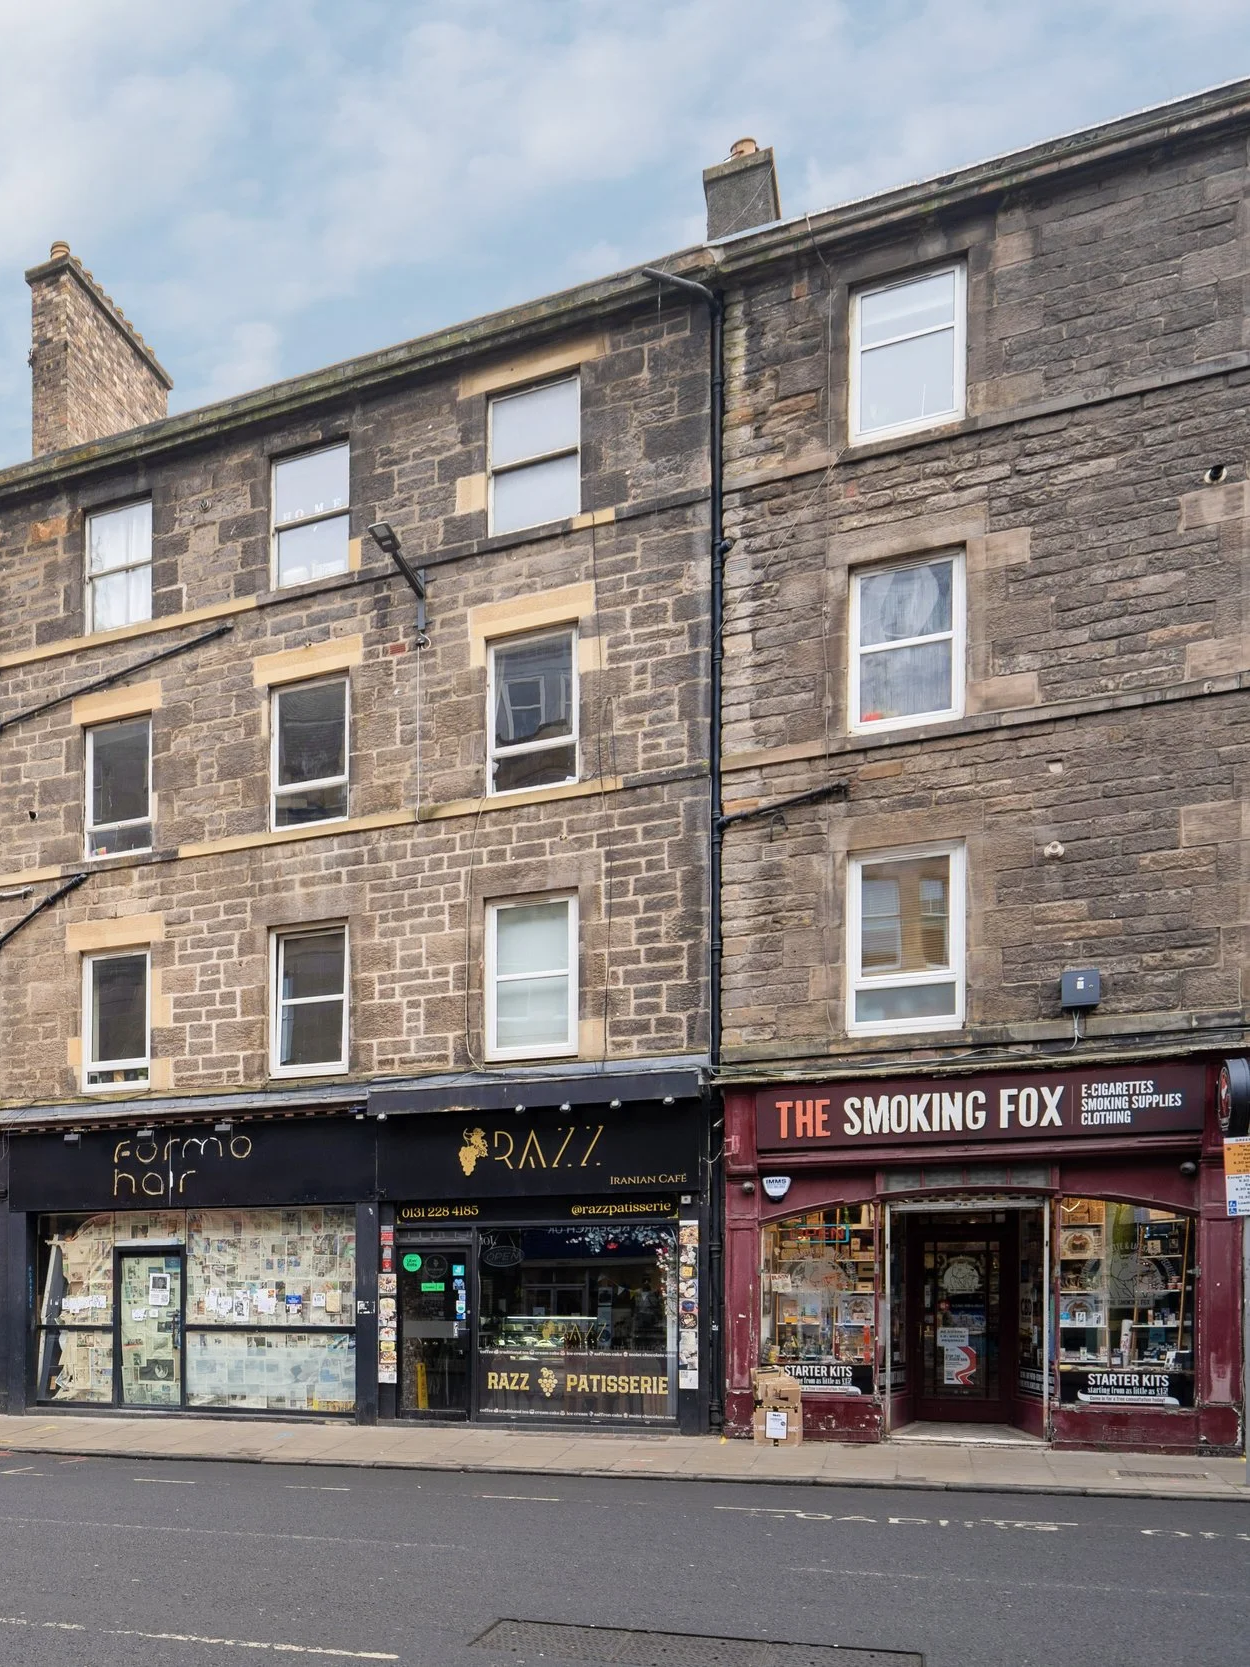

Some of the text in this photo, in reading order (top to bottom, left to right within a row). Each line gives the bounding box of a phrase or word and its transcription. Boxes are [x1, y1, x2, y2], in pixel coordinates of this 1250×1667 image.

[1082, 1080, 1154, 1096] E-CIGARETTES
[1081, 1094, 1181, 1111] SMOKING SUPPLIES
[776, 1086, 1064, 1138] THE SMOKING FOX
[1081, 1111, 1131, 1125] CLOTHING
[494, 1126, 604, 1169] RAZZ
[402, 1206, 478, 1218] 0131 228 4185
[572, 1202, 671, 1216] @razzpatisserie
[784, 1366, 852, 1377] STARTER KITS
[488, 1372, 668, 1394] RAZZ PATISSERIE
[1088, 1374, 1169, 1387] STARTER KITS
[1088, 1386, 1111, 1395] starting
[1112, 1386, 1125, 1394] from
